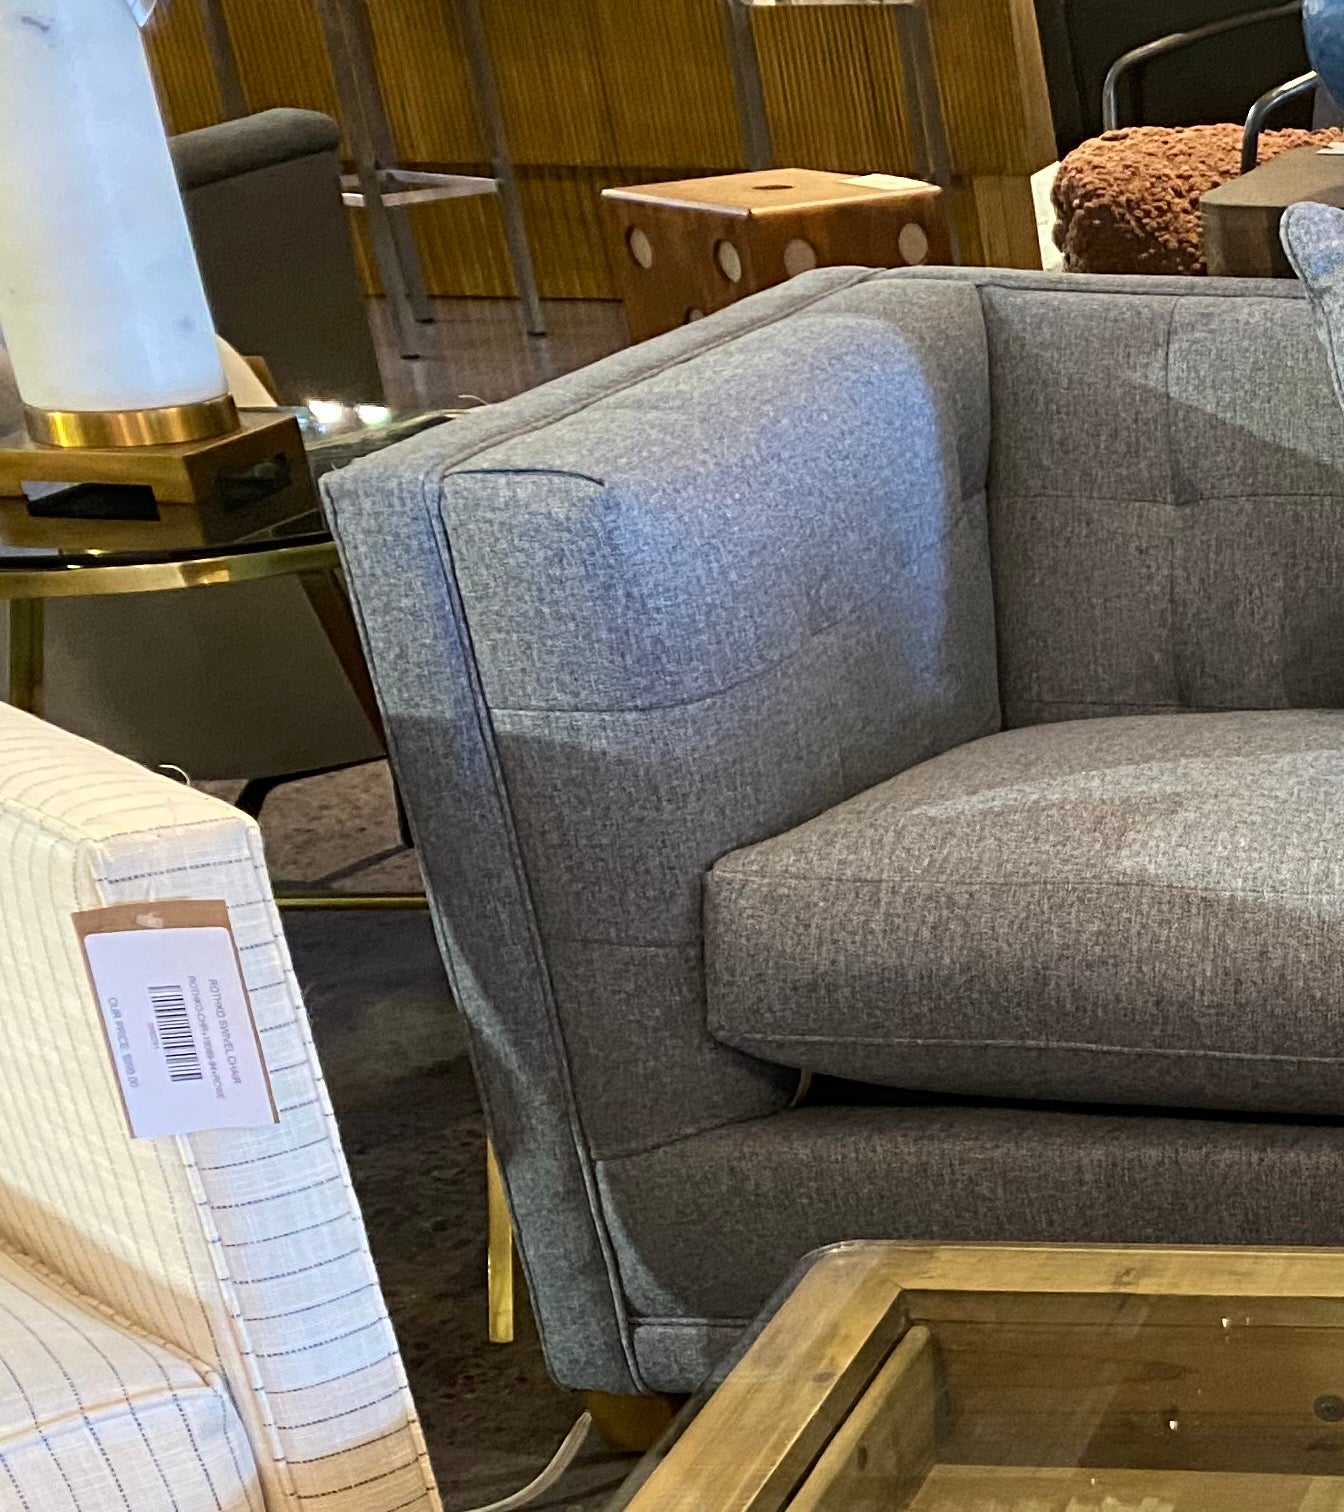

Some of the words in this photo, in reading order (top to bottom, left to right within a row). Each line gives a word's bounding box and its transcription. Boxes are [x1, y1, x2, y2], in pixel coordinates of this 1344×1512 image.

[108, 997, 122, 1018] OUR
[209, 979, 225, 1017] ROTHKO
[219, 1017, 234, 1056] SWIVEL
[227, 1056, 242, 1084] CHAIR
